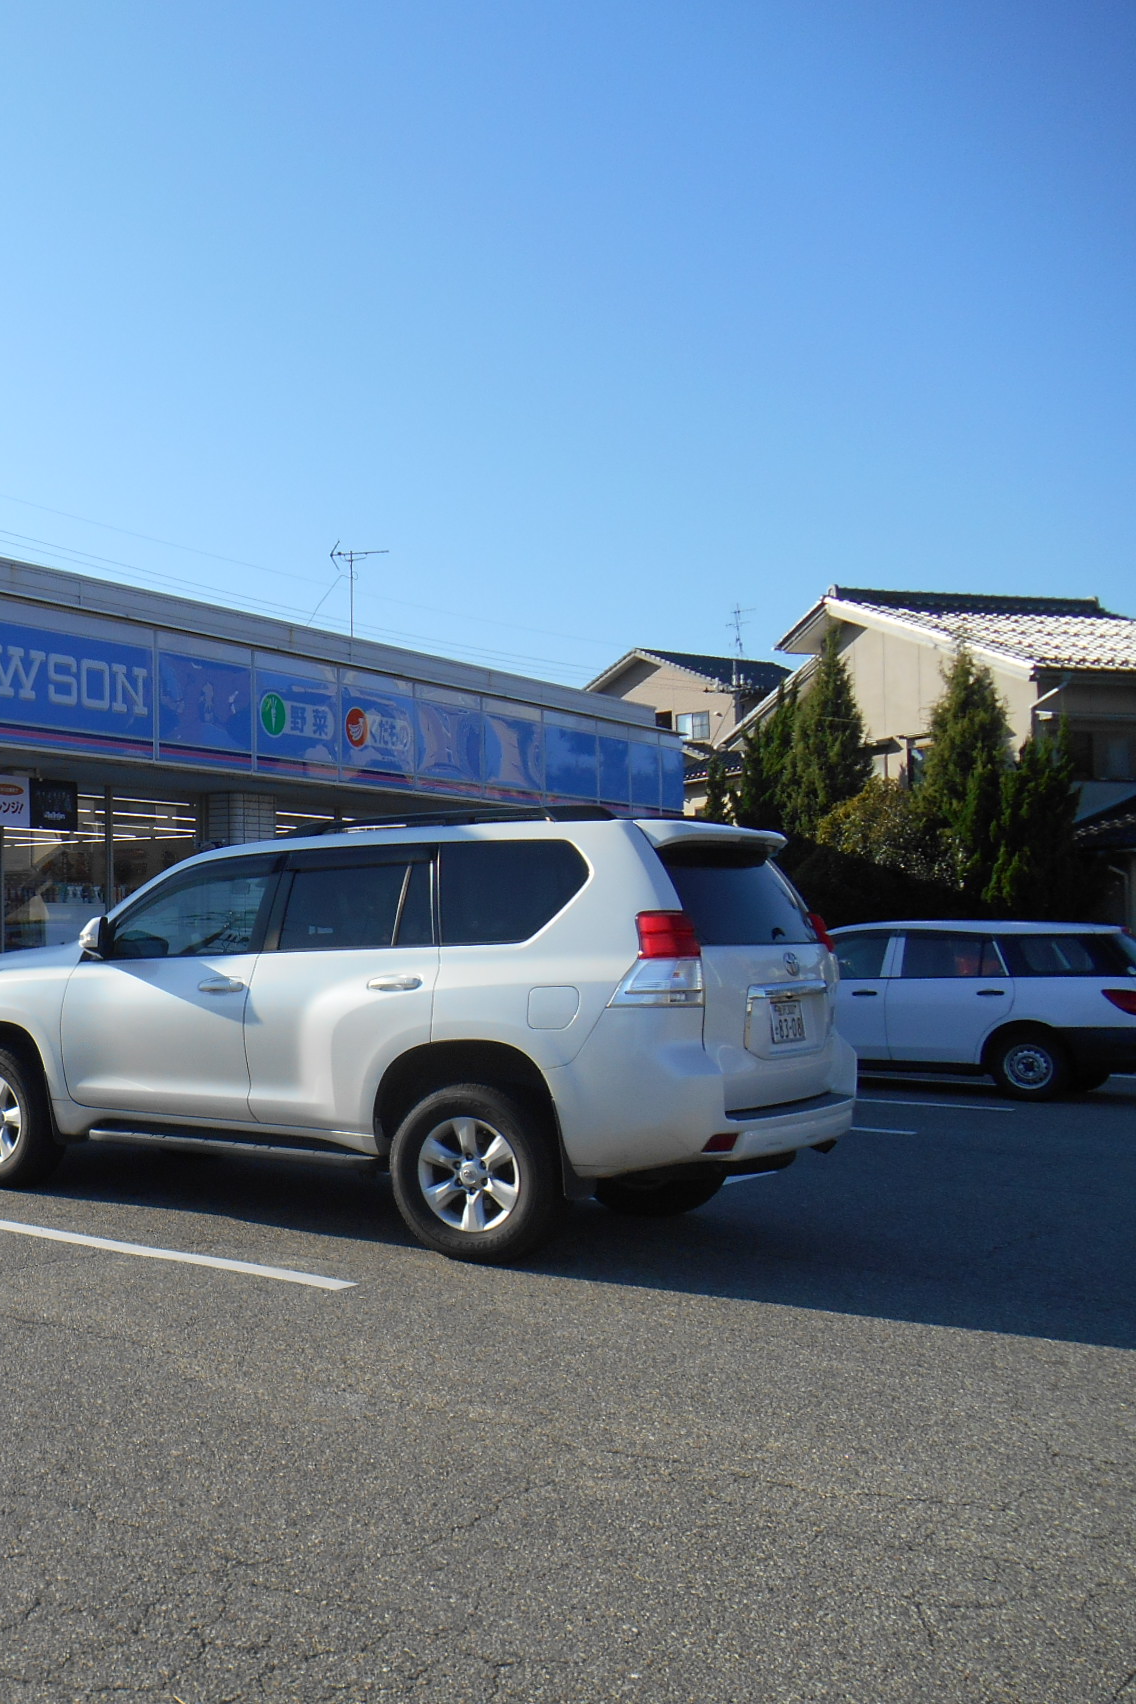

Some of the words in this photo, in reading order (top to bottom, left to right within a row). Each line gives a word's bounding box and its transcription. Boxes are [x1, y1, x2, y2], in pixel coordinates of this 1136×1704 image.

[290, 704, 329, 737] 野菜
[369, 718, 410, 748] くだもの
